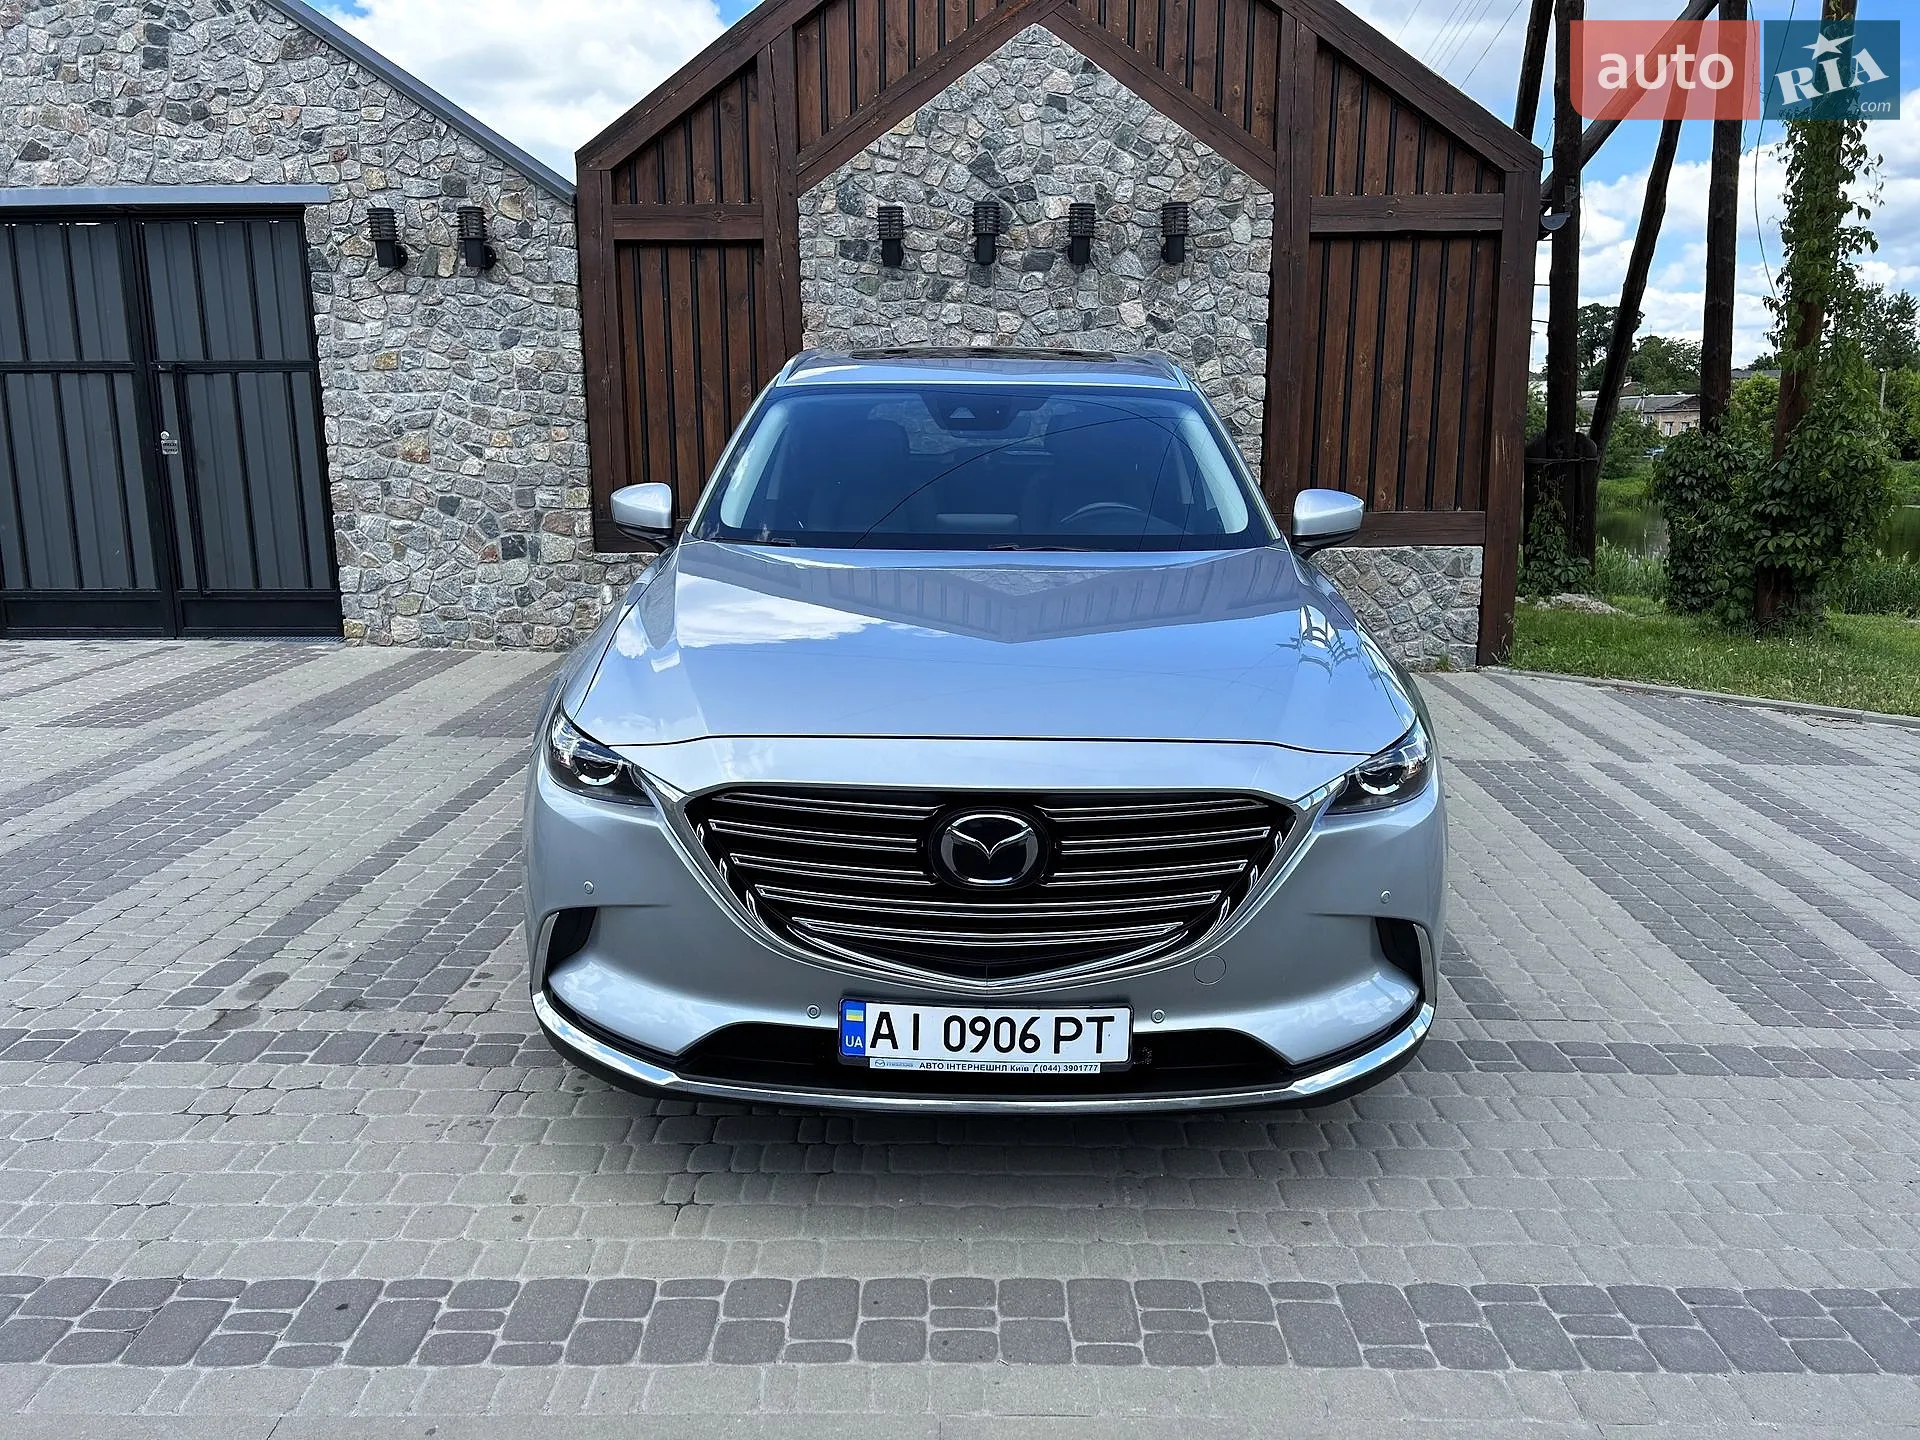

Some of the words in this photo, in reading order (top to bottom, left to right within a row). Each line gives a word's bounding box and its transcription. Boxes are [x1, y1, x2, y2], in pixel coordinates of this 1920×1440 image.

[869, 1011, 920, 1051] AI
[943, 1014, 1041, 1053] 0906
[1053, 1016, 1115, 1055] PT
[845, 1035, 863, 1048] UA
[919, 1062, 944, 1070] АВТО
[1039, 1064, 1061, 1073] (044)
[1063, 1064, 1099, 1072] 3901777
